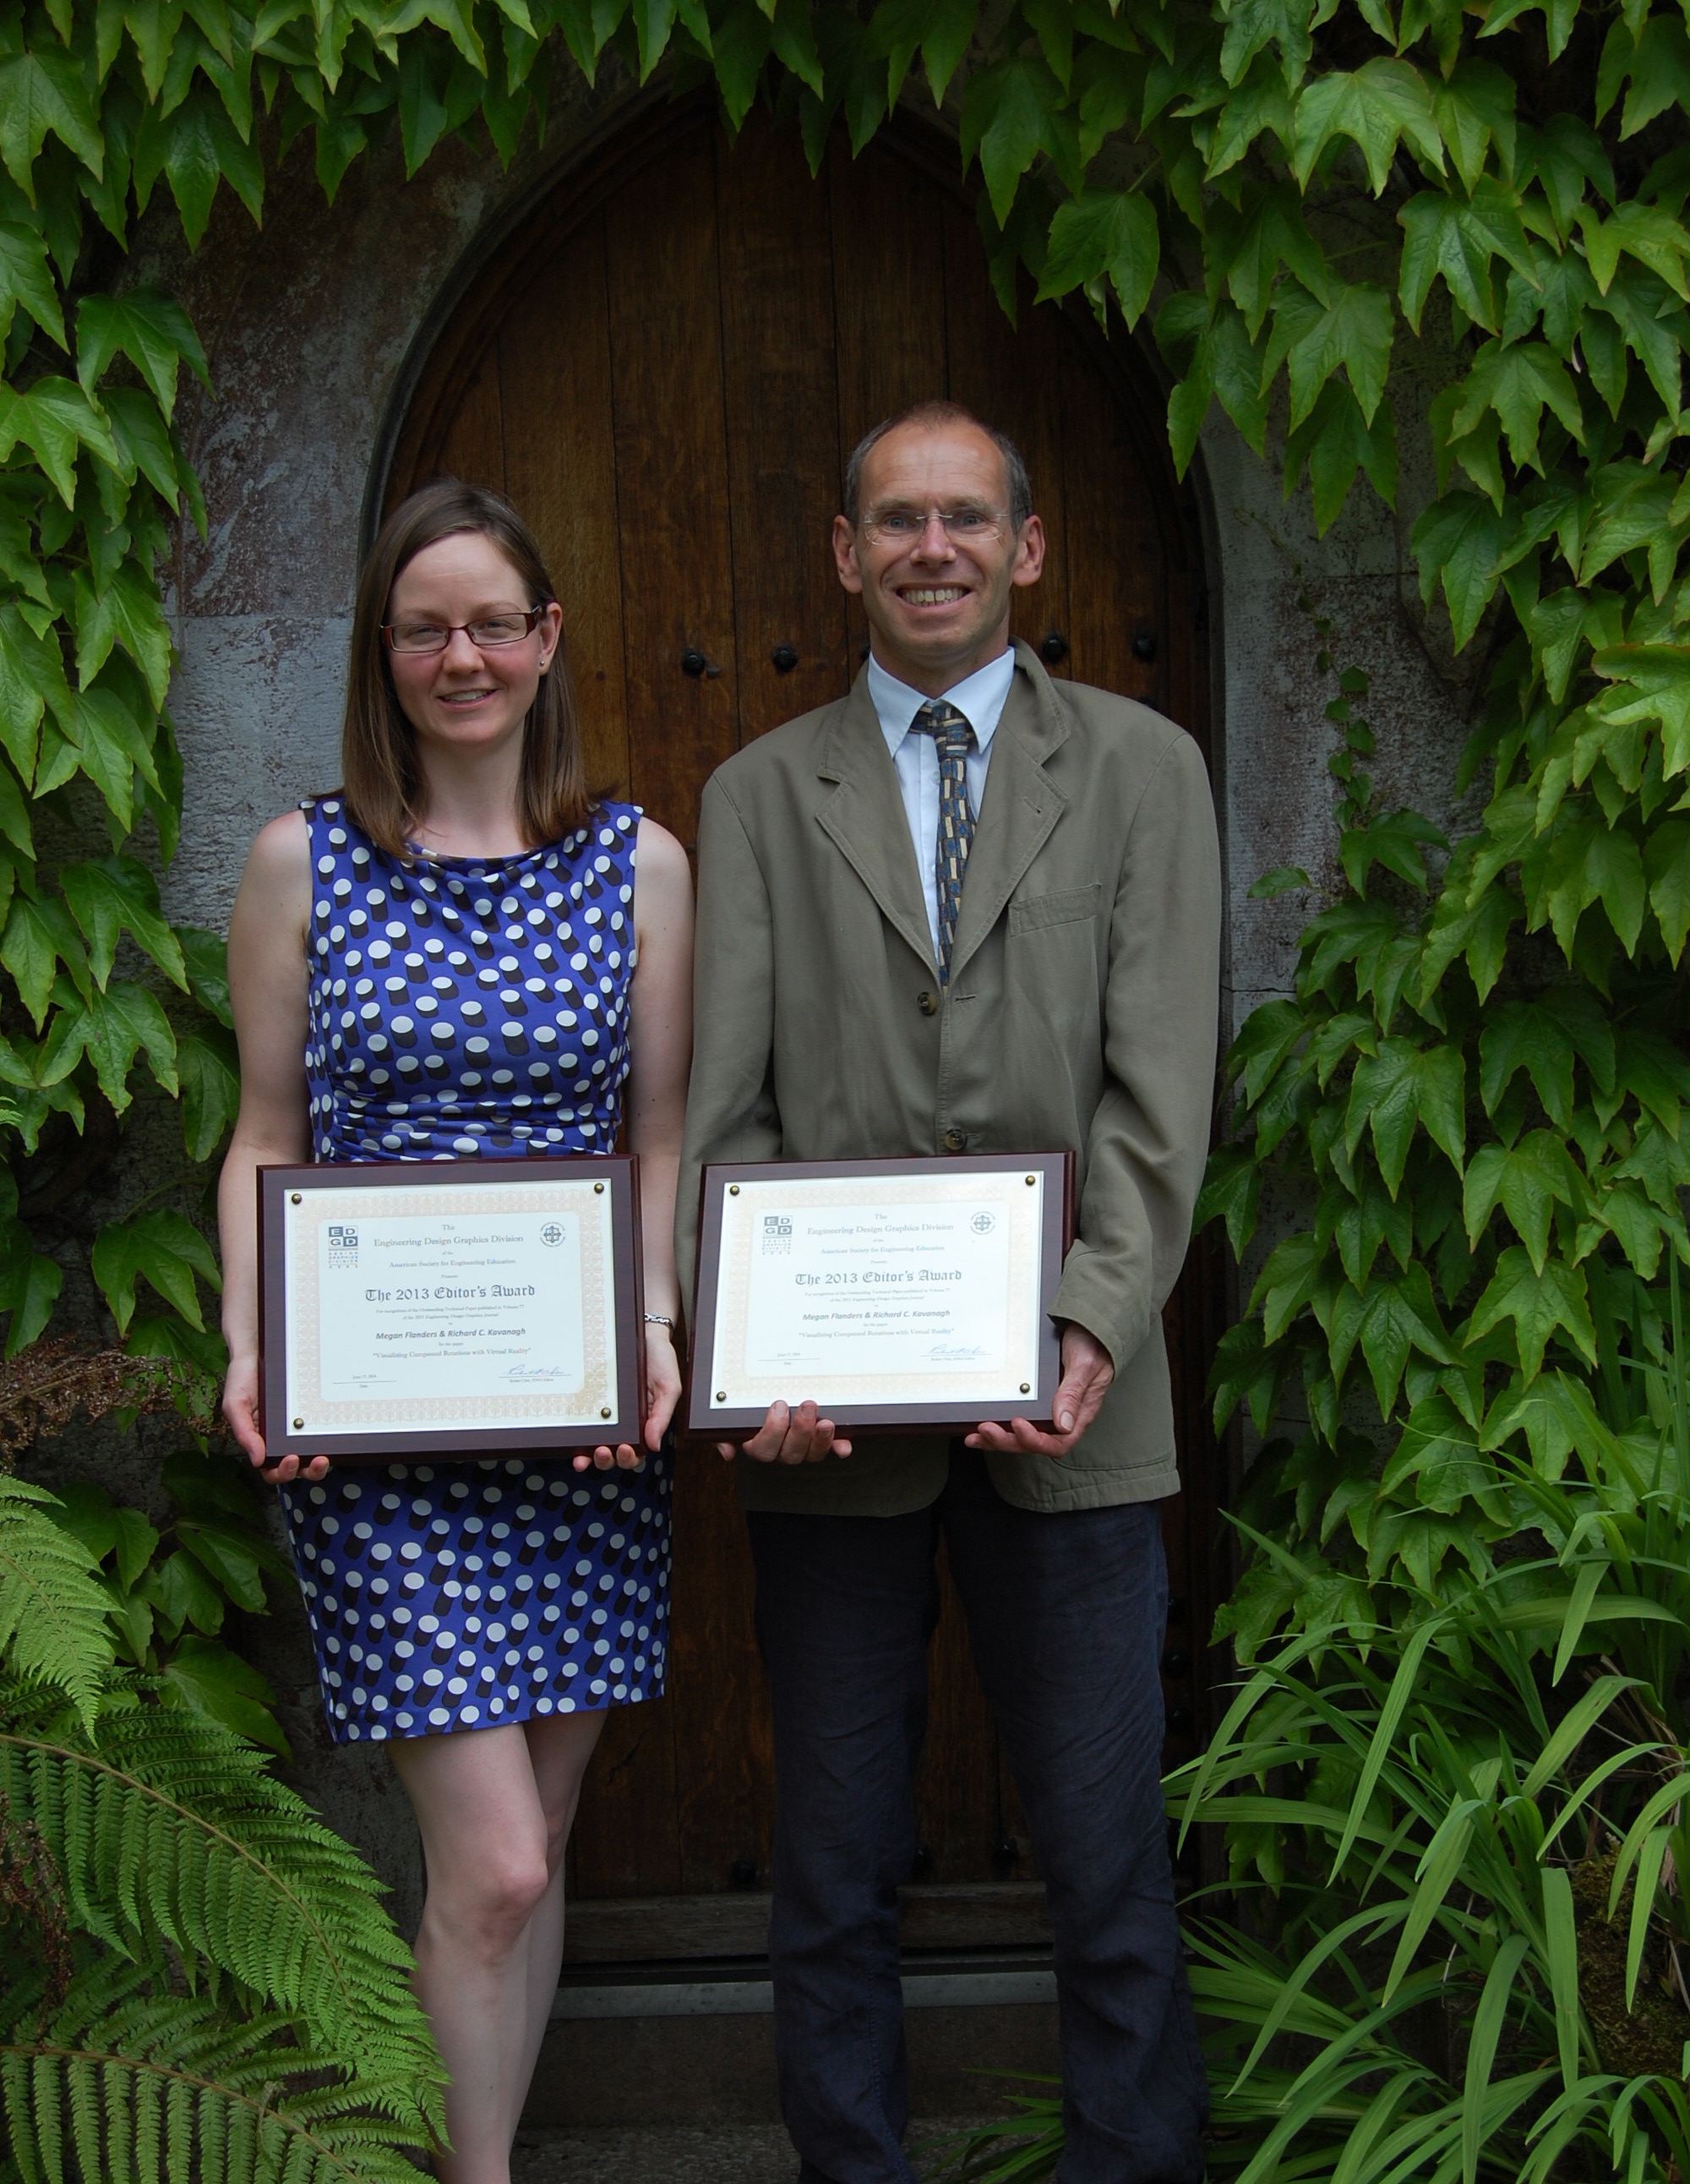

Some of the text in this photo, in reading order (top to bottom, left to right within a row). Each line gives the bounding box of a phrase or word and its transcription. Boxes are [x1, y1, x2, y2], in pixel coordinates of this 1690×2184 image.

[808, 1227, 853, 1236] Engineering
[885, 1225, 919, 1233] Graphics
[374, 1238, 422, 1248] Engineering
[454, 1237, 488, 1245] Graphics
[795, 1269, 962, 1286] The 2013 Editor's Award
[365, 1285, 535, 1302] The 2013 Editor's Award
[448, 1329, 476, 1337] Richard
[488, 1328, 526, 1336] Kavanagh
